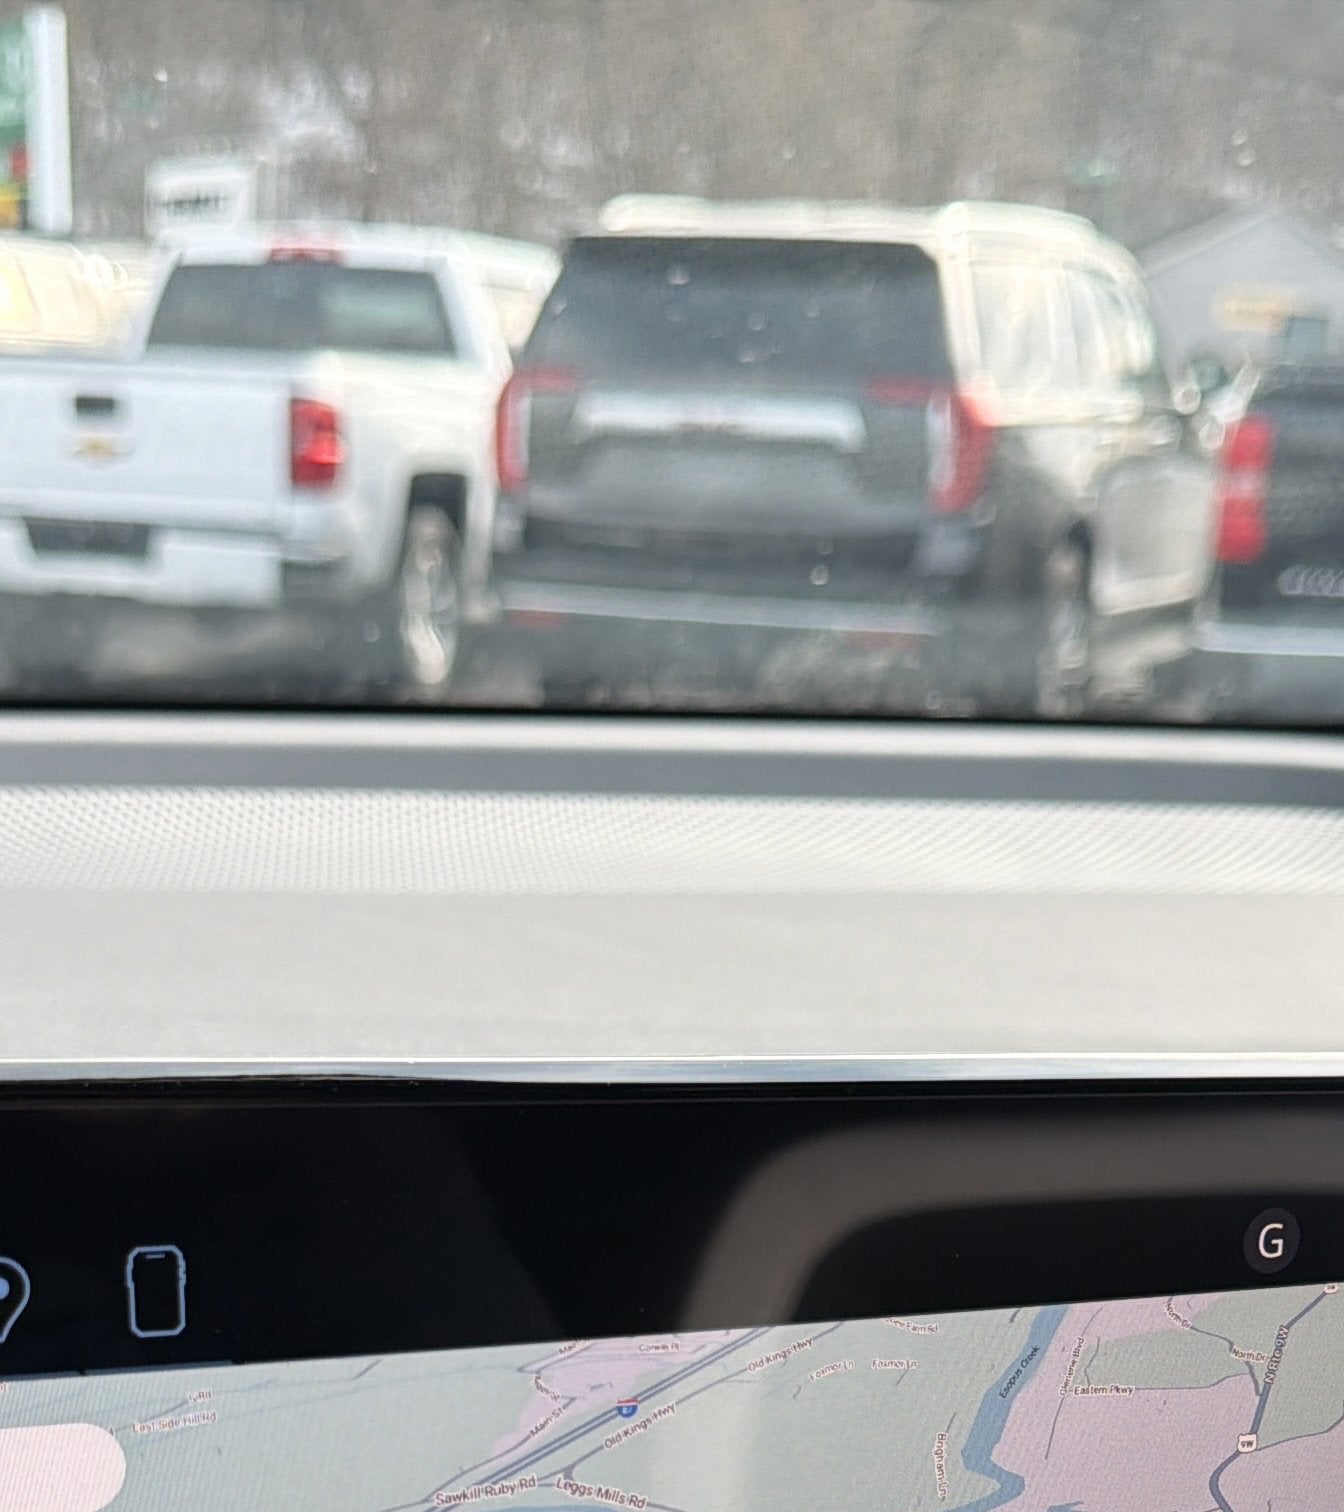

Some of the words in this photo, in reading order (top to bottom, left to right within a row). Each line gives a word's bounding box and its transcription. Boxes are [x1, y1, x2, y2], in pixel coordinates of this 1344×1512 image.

[1258, 1223, 1284, 1259] G
[748, 1357, 765, 1371] Old
[1074, 1386, 1107, 1395] Eastern
[605, 1432, 623, 1448] Old
[625, 1416, 652, 1437] Kings
[655, 1403, 675, 1421] Hwy
[1240, 1438, 1254, 1448] 9W
[435, 1487, 480, 1505] Sawkill
[484, 1481, 518, 1499] Ruby
[520, 1477, 536, 1490] Rd
[556, 1478, 593, 1497] Leggs
[596, 1486, 625, 1505] Mills
[628, 1493, 645, 1508] Rd
